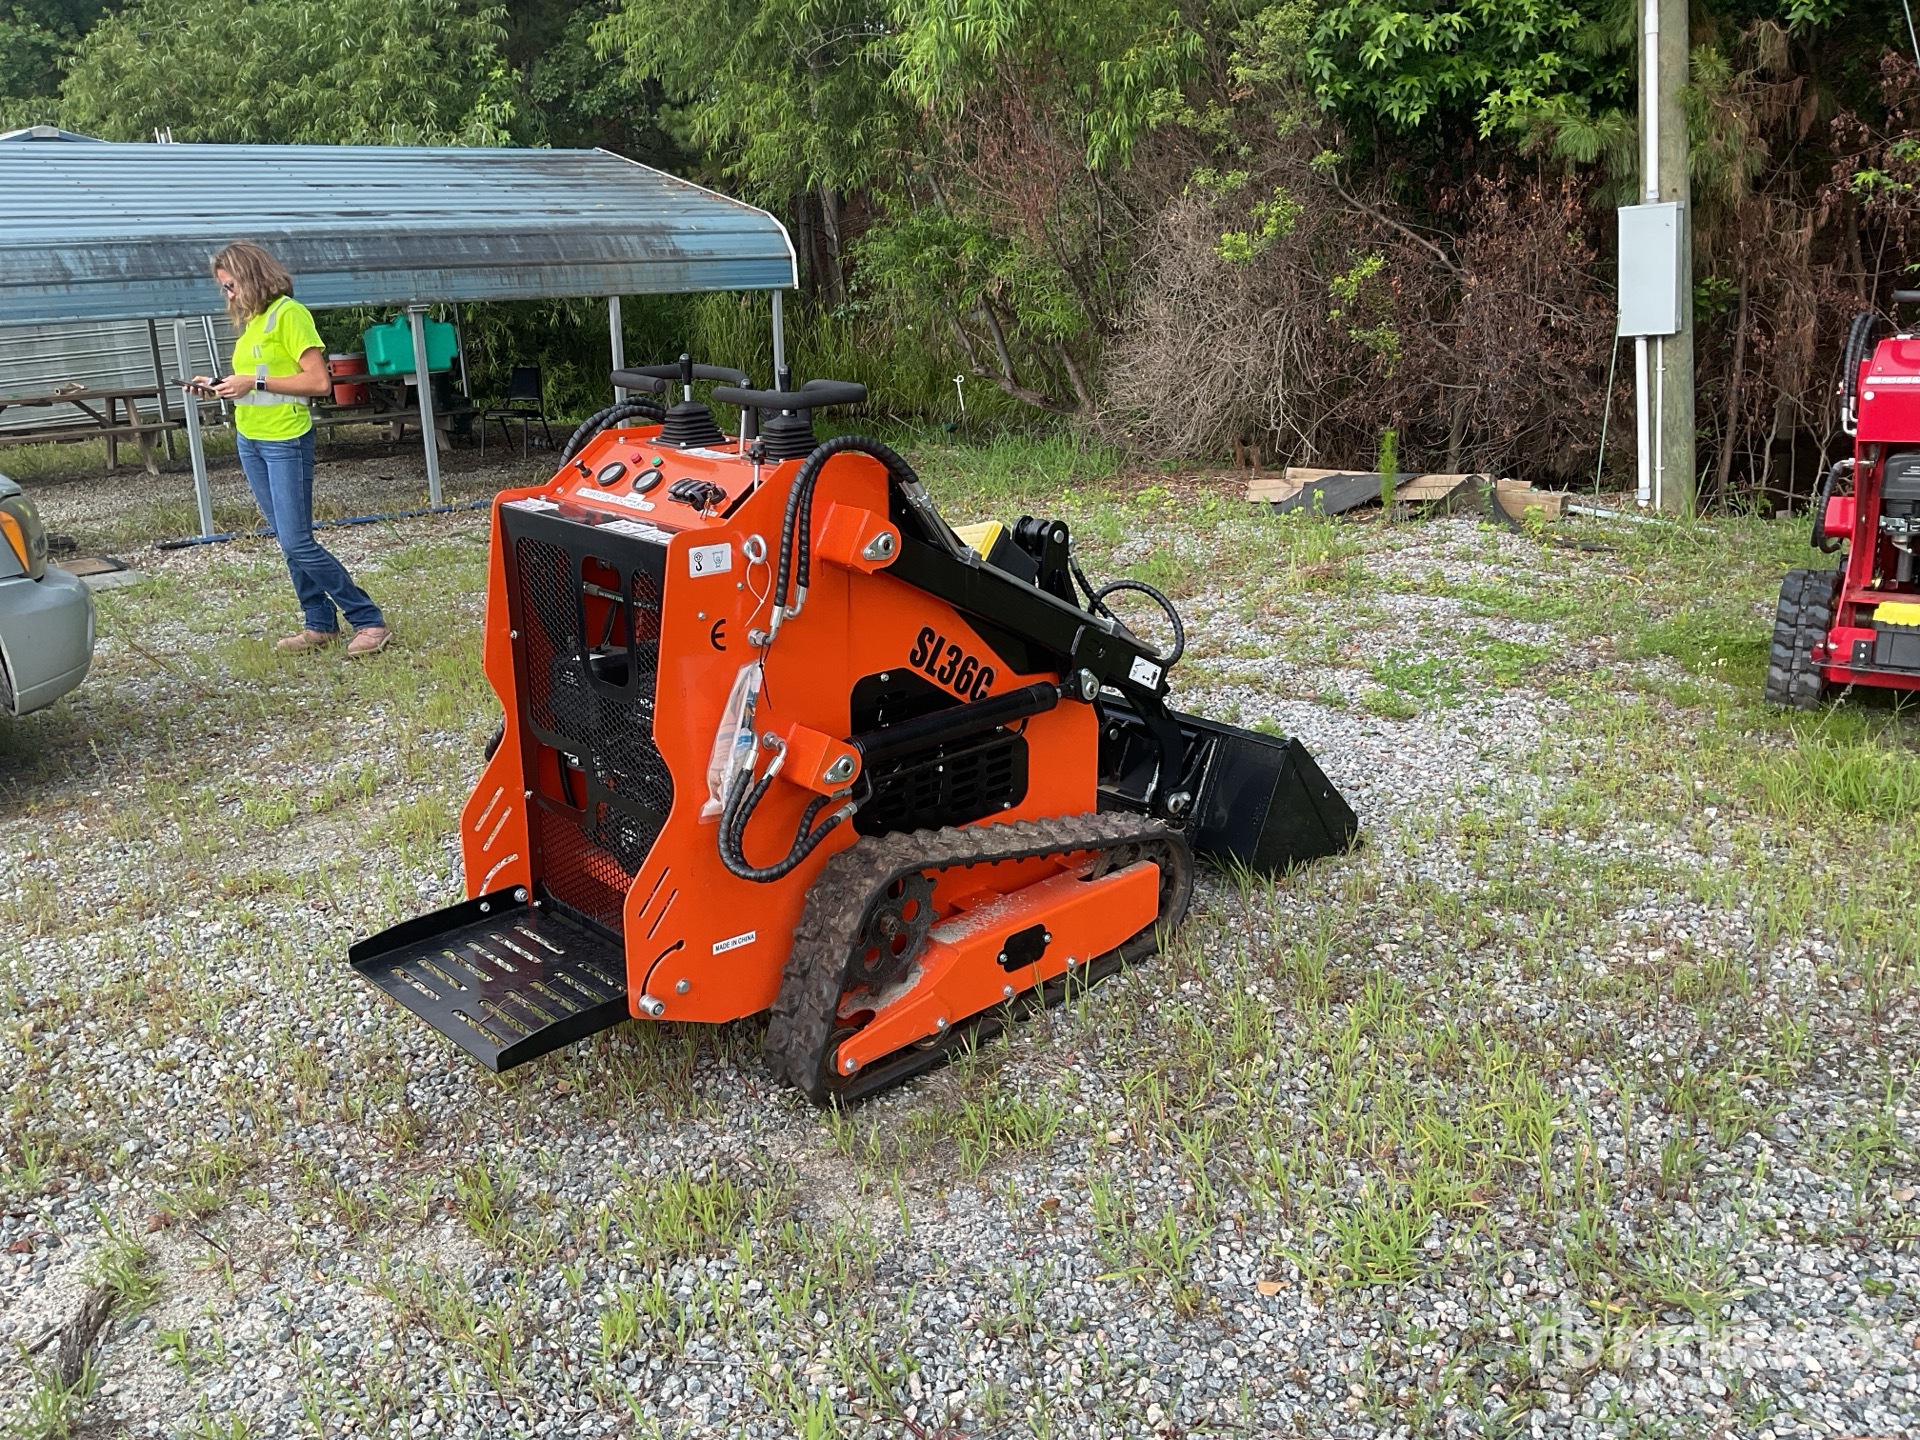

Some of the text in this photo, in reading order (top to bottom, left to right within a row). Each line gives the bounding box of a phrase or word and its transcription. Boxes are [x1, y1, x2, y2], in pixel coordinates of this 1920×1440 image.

[909, 626, 995, 702] SL36C
[715, 941, 731, 952] MADE
[737, 933, 755, 945] CHINA
